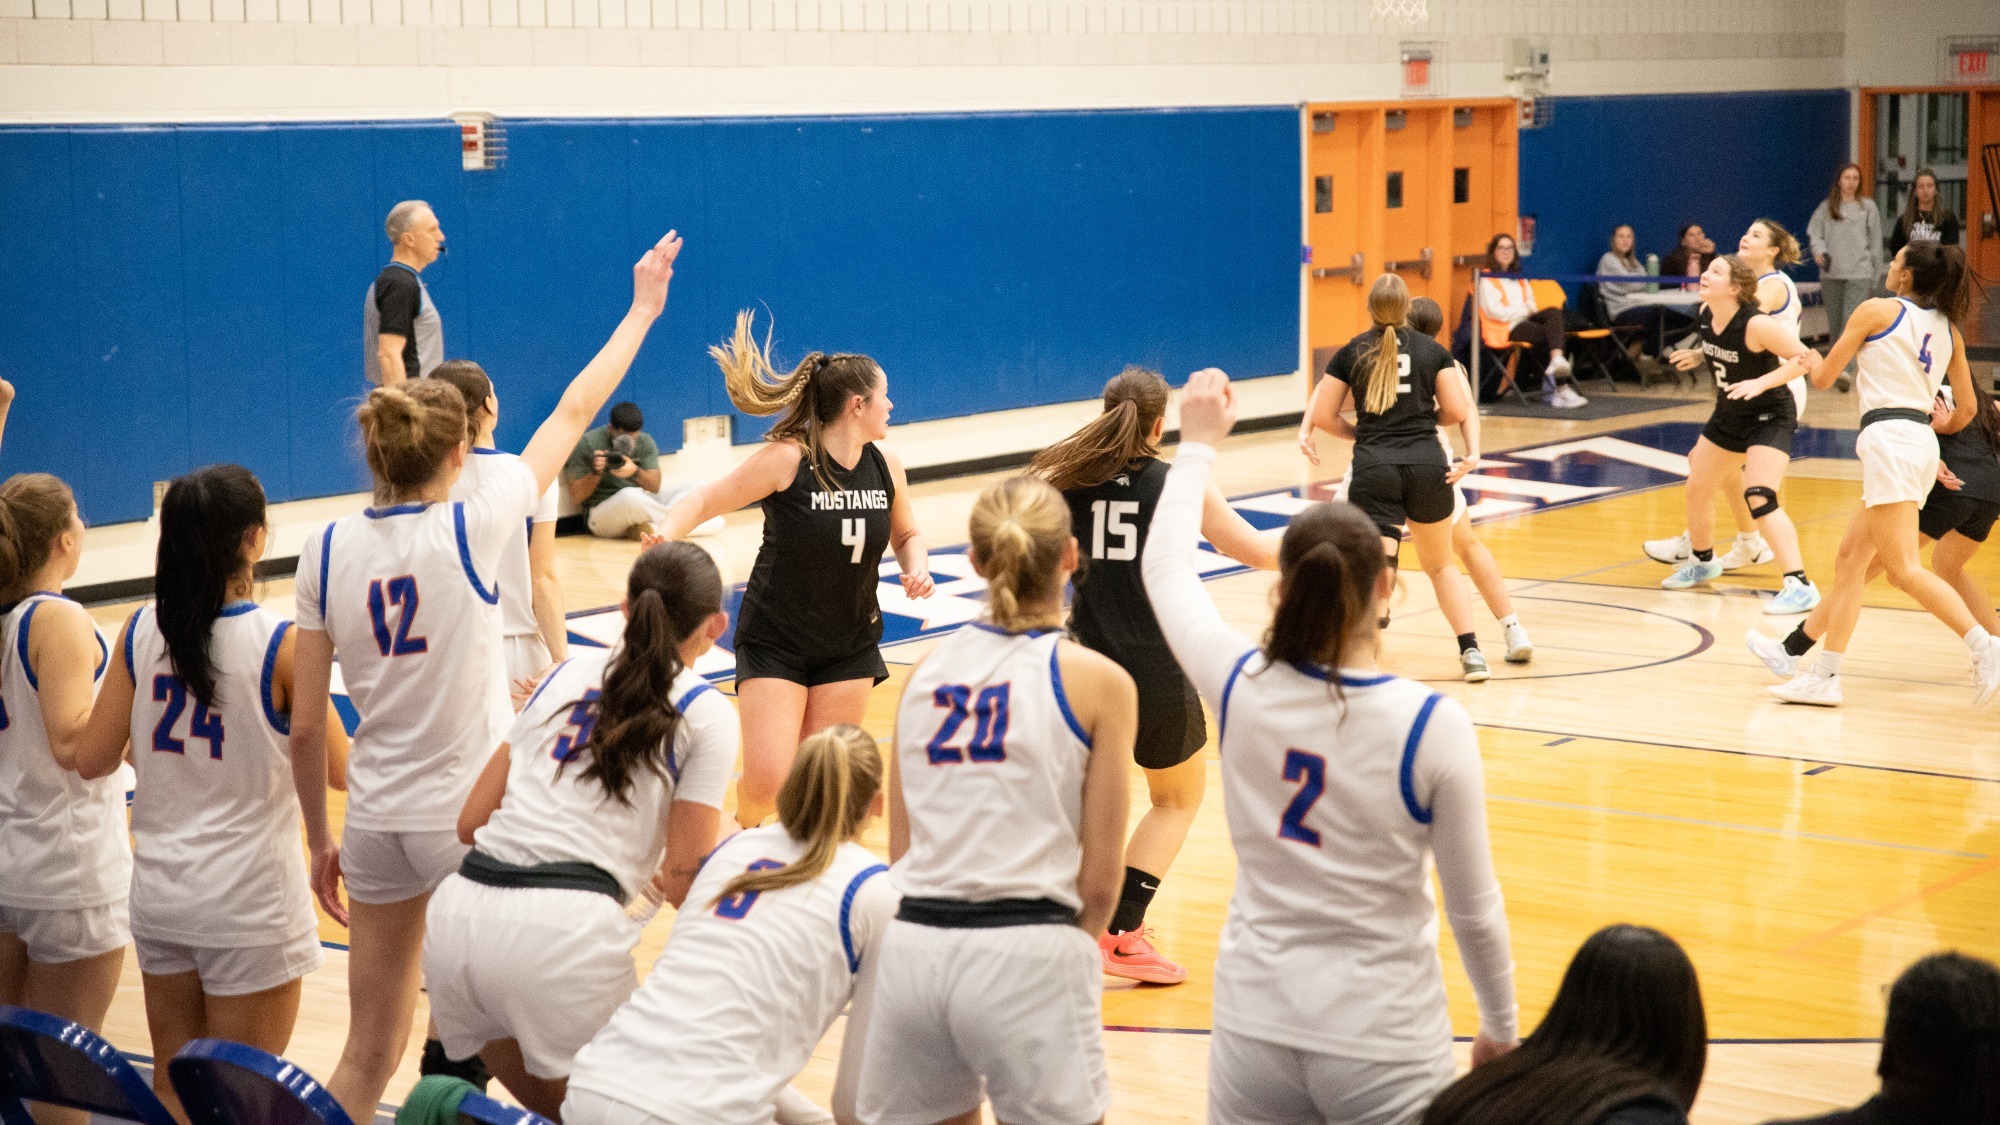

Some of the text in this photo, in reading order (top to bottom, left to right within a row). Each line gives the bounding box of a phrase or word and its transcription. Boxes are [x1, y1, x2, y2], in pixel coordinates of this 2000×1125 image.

[1712, 361, 1729, 389] 2
[1918, 333, 1933, 375] 4
[811, 489, 888, 510] MUSTANGS
[1091, 499, 1140, 562] 15
[841, 517, 866, 564] 4
[366, 573, 428, 657] 12
[151, 673, 225, 761] 24
[925, 680, 1010, 766] 20
[1277, 747, 1327, 849] 2
